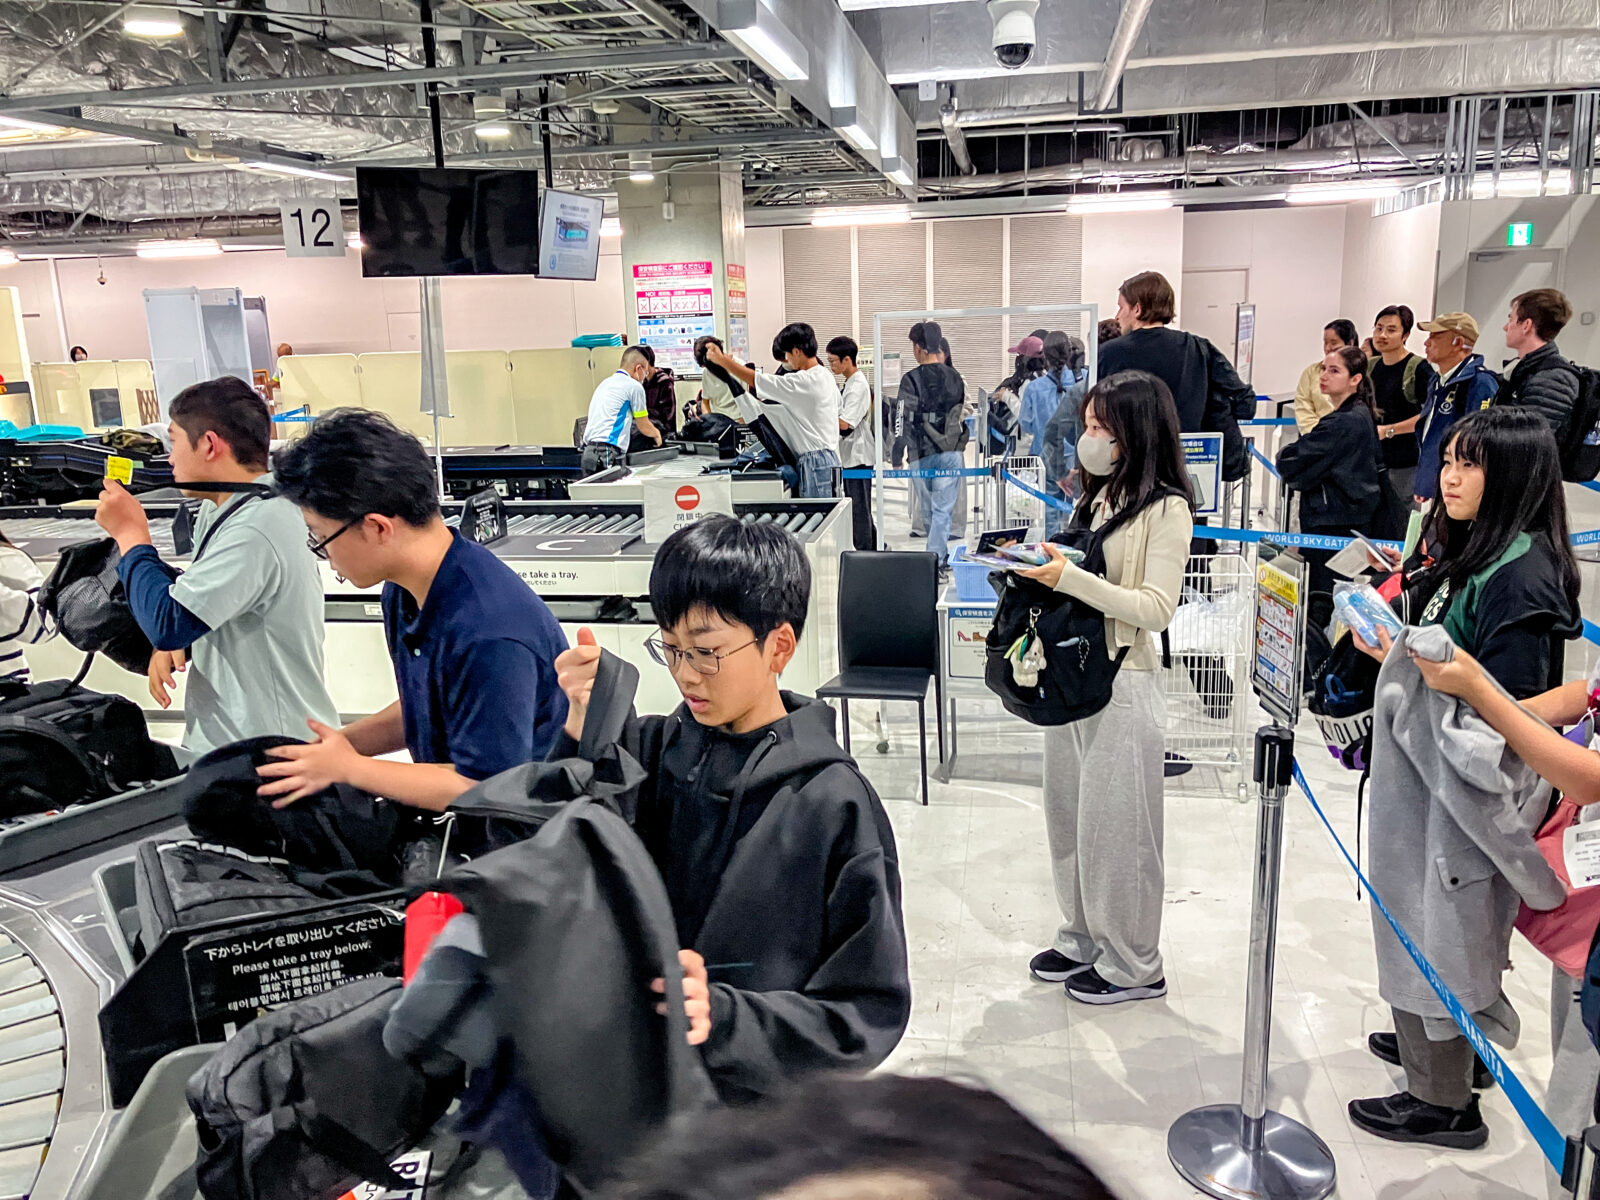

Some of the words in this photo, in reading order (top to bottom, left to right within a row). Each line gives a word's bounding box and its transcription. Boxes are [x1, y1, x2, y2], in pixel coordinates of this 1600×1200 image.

[290, 208, 334, 247] 12
[1264, 533, 1300, 545] WORLD
[1303, 535, 1322, 546] SKY
[1324, 536, 1350, 547] GATE
[530, 570, 549, 578] take
[559, 571, 579, 580] tray.
[232, 961, 270, 975] Please
[272, 954, 297, 967] take
[300, 954, 307, 962] a
[310, 948, 332, 960] tray
[334, 940, 372, 955] below.
